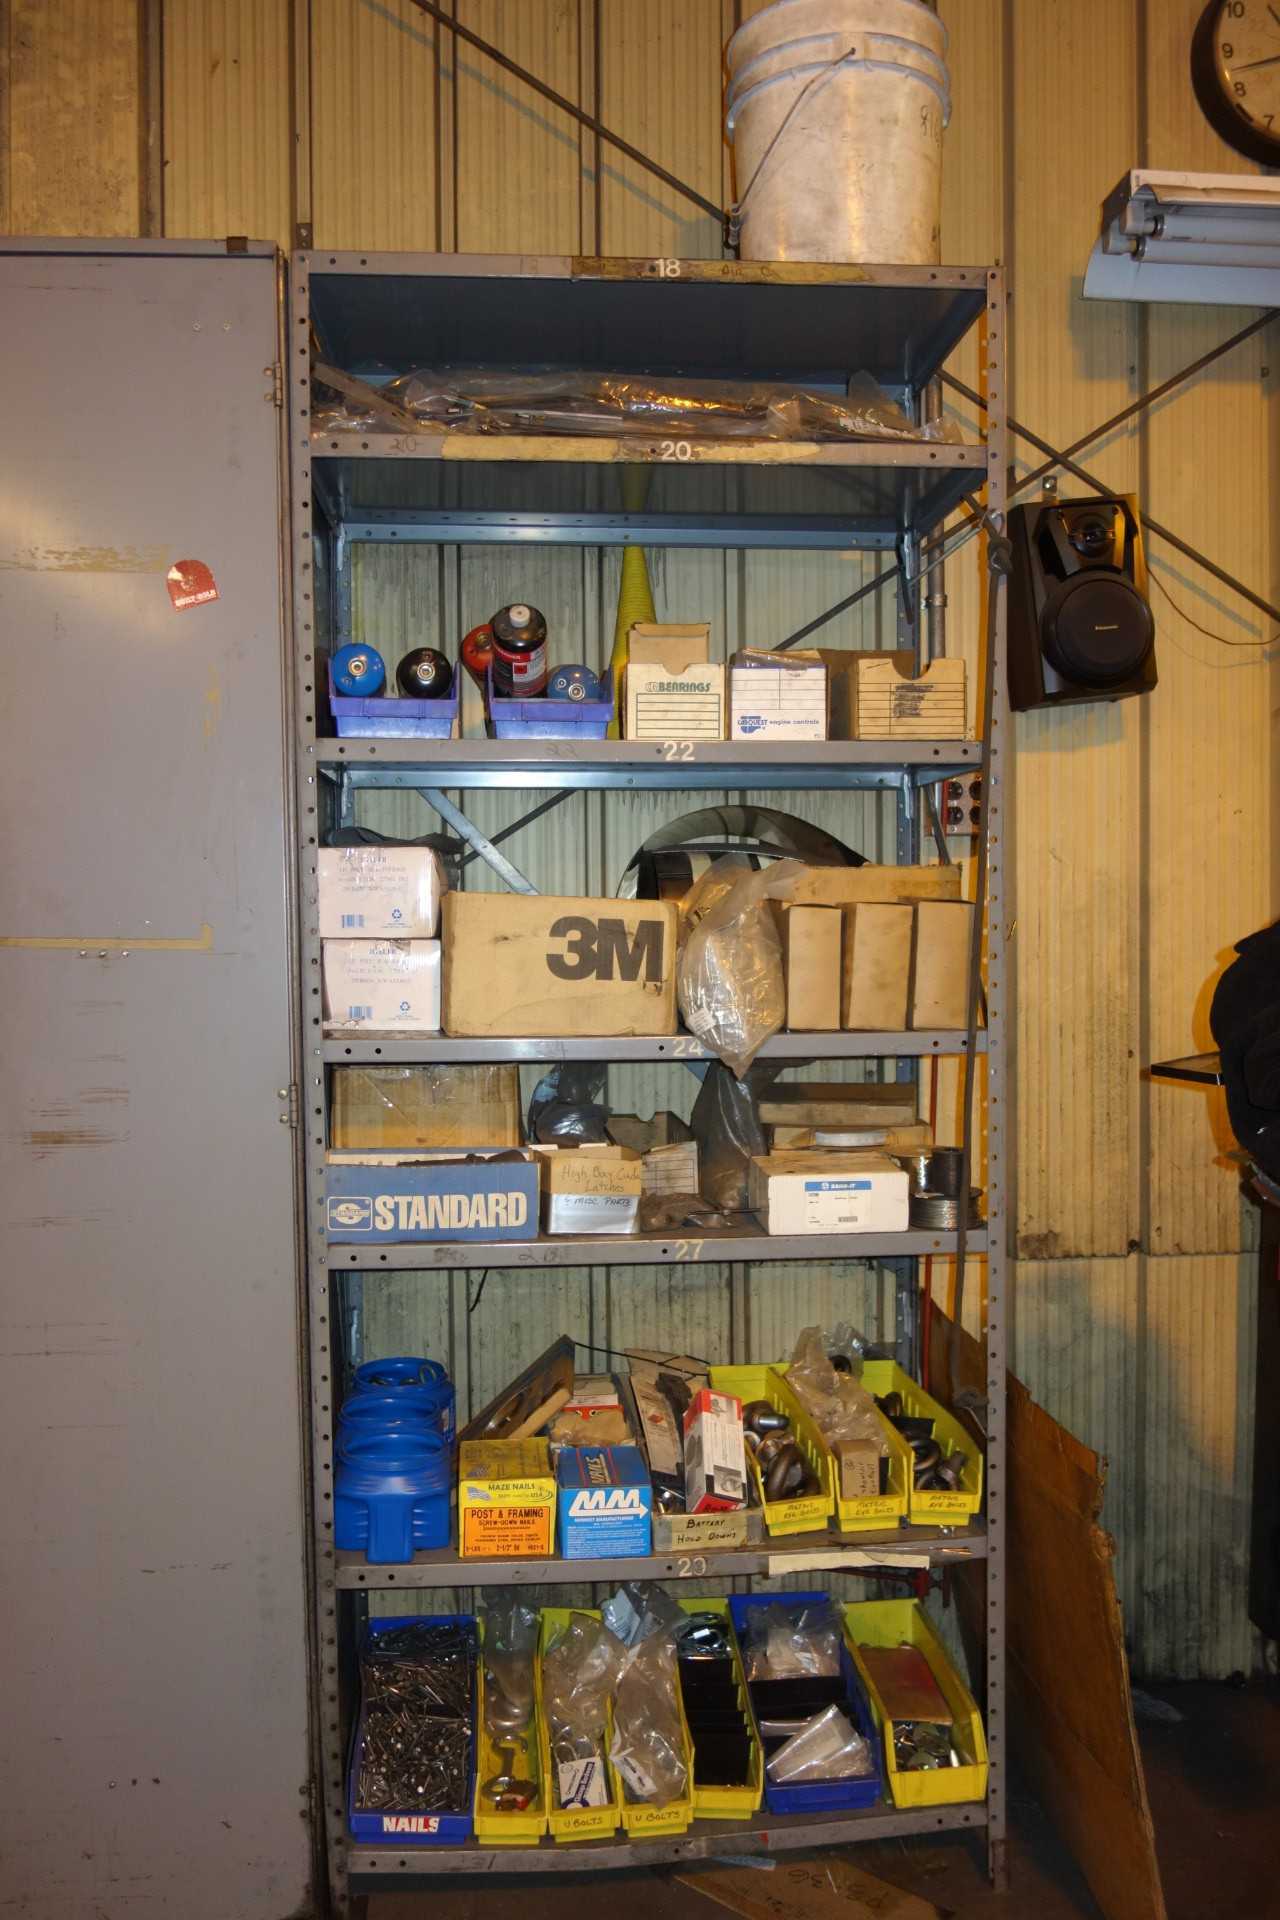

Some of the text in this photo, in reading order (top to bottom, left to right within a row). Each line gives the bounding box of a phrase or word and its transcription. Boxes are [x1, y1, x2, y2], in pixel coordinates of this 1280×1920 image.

[1227, 1, 1244, 18] 10
[1222, 43, 1233, 58] 9
[1234, 82, 1246, 97] 8
[1264, 115, 1274, 129] 7
[655, 259, 681, 278] 18
[660, 441, 691, 461] 20
[658, 682, 711, 692] BEARINGS
[663, 741, 695, 761] 22
[546, 916, 664, 982] 3M
[673, 1039, 704, 1057] 24
[374, 1192, 527, 1231] STANDARD
[675, 1240, 704, 1261] 27
[472, 1509, 543, 1519] POST & FRAMING
[383, 1815, 440, 1833] NAILS
